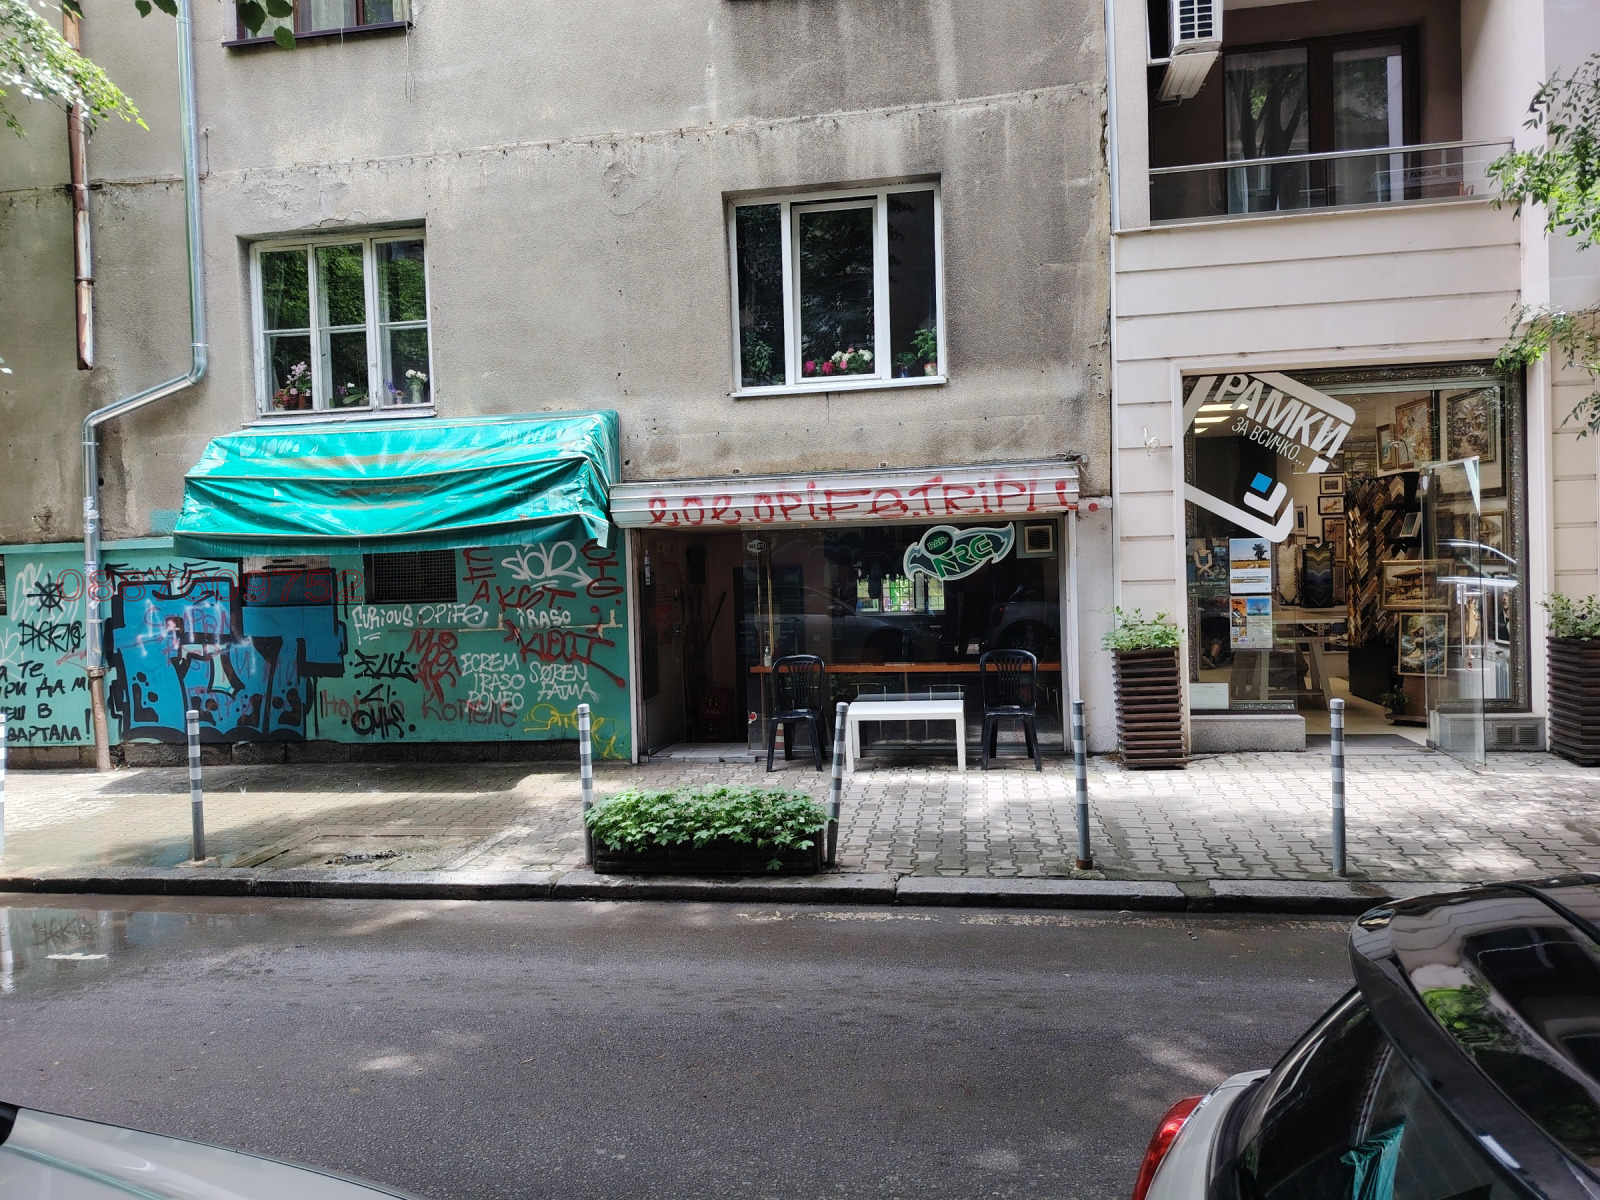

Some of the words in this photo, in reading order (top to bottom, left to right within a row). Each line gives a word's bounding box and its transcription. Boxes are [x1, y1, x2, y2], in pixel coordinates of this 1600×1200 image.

[1213, 373, 1351, 459] РАМКИ
[1231, 416, 1250, 437] ЗА
[1249, 425, 1306, 467] ВСИЧКО...
